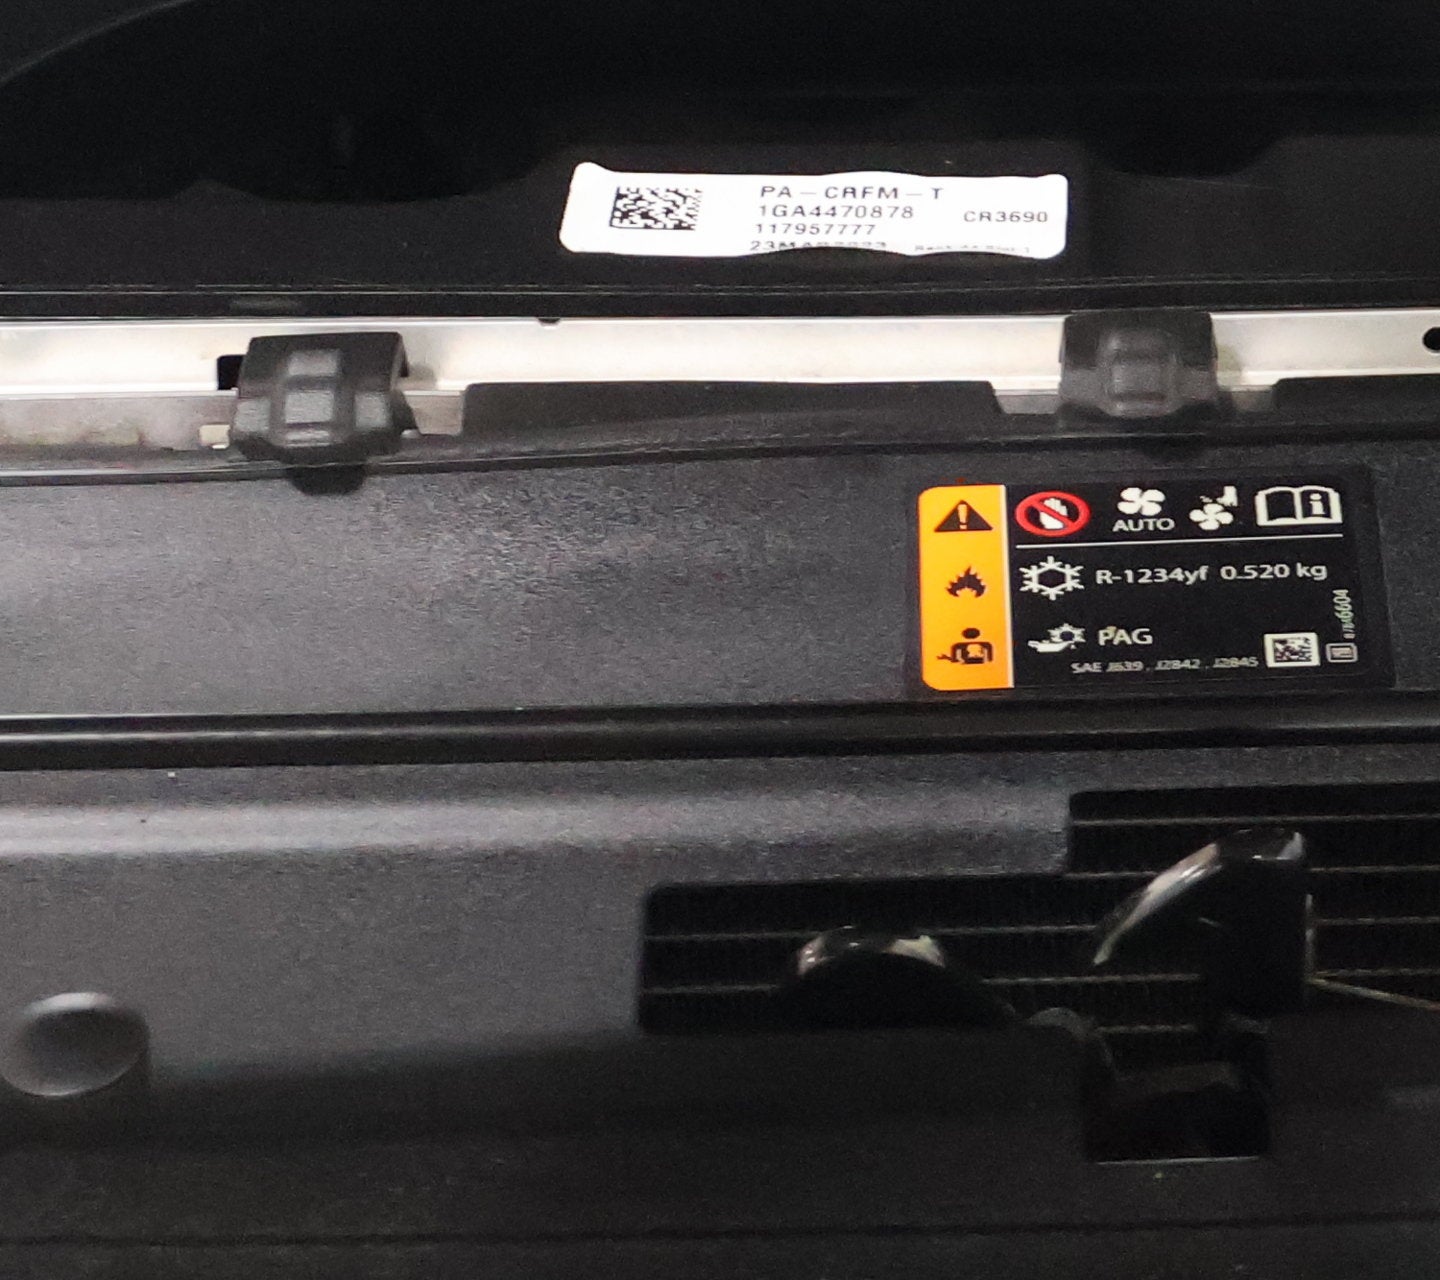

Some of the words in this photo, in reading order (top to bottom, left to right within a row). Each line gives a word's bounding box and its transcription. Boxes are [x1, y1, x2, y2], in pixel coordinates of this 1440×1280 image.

[759, 204, 914, 219] 1GA4470878
[963, 210, 1048, 223] CR3690
[755, 223, 876, 236] 117957777
[1112, 516, 1175, 532] AUTO
[1095, 565, 1209, 586] R-1234yf
[1220, 563, 1290, 580] 0.520
[1296, 562, 1328, 581] kg
[1098, 627, 1153, 646] PAG
[1070, 661, 1102, 674] SAE
